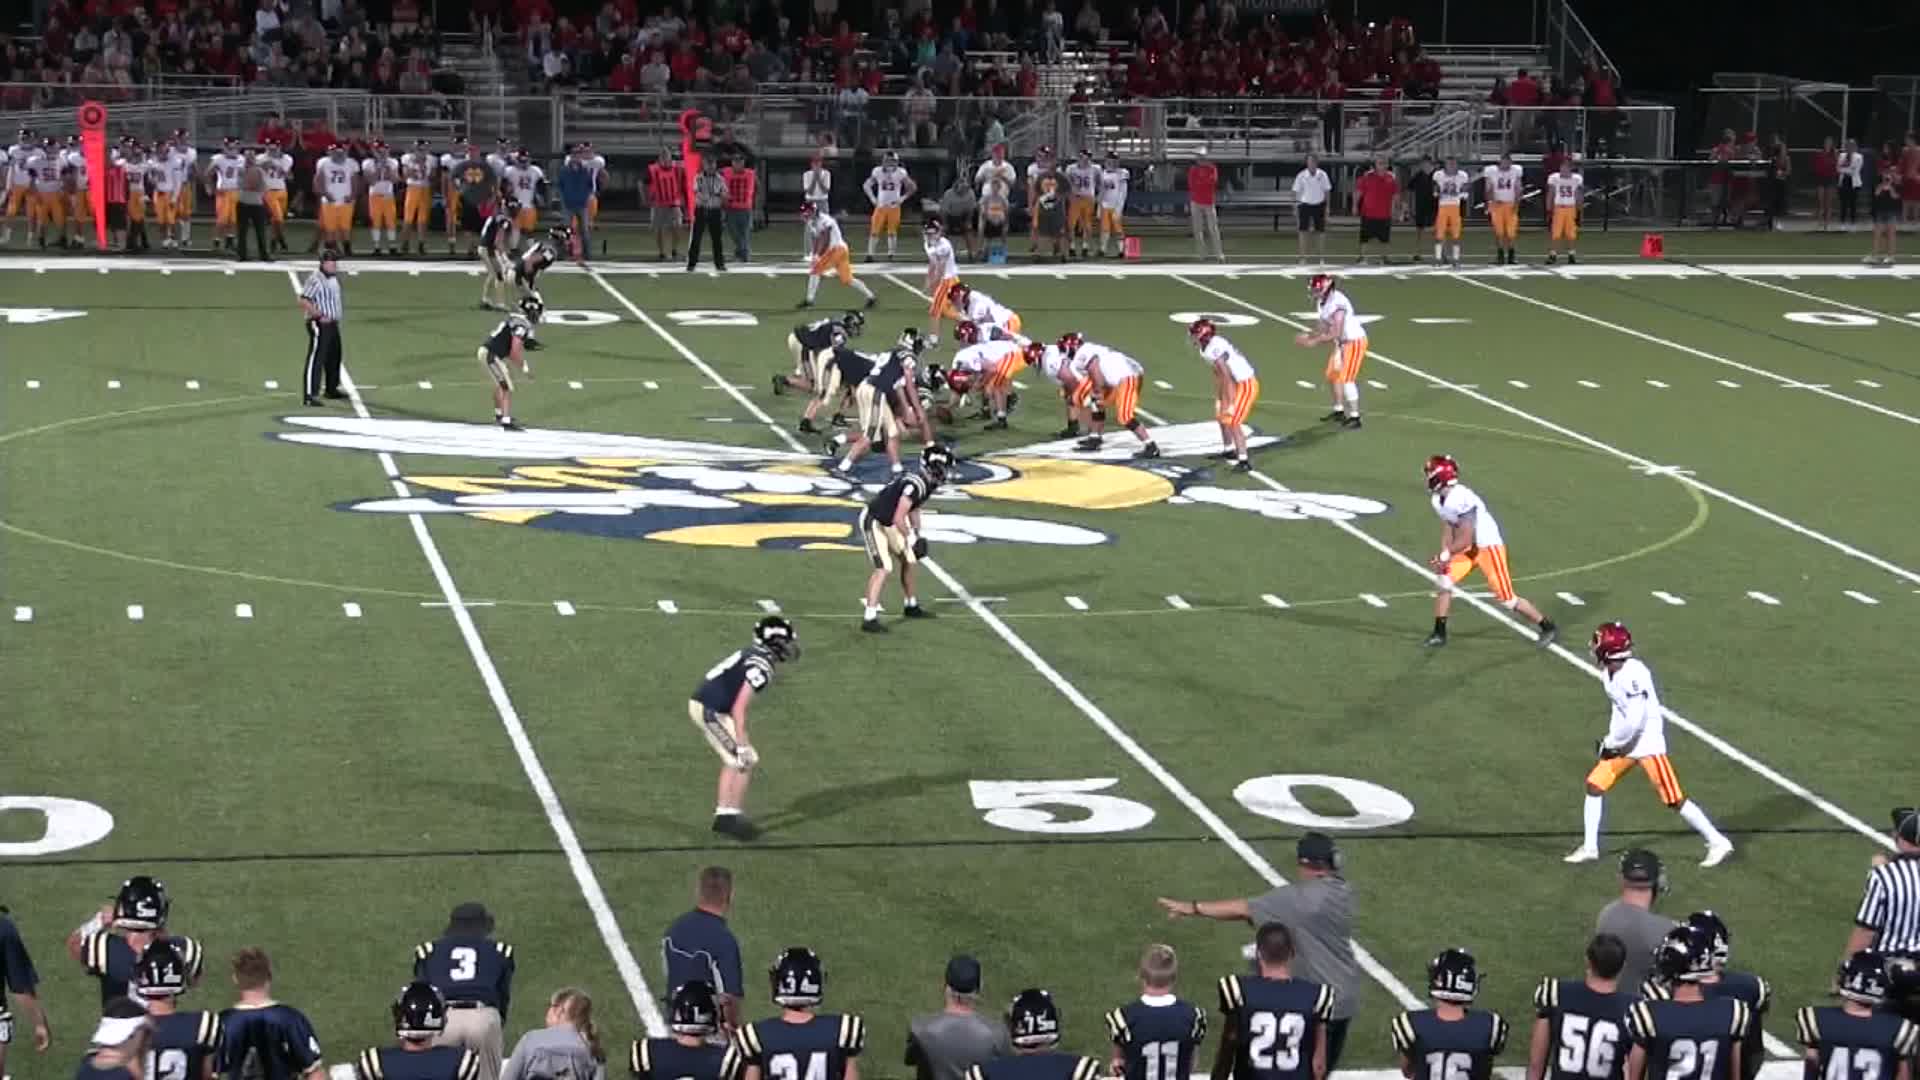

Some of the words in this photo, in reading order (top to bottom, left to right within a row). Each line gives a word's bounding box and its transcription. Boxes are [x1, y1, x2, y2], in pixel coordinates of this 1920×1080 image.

[968, 776, 1416, 834] 50
[449, 946, 477, 982] 3
[1141, 1040, 1180, 1080] 11
[1249, 1010, 1306, 1071] 23
[1557, 1012, 1620, 1079] 56
[1664, 1037, 1719, 1080] 21
[1425, 1051, 1473, 1080] 16
